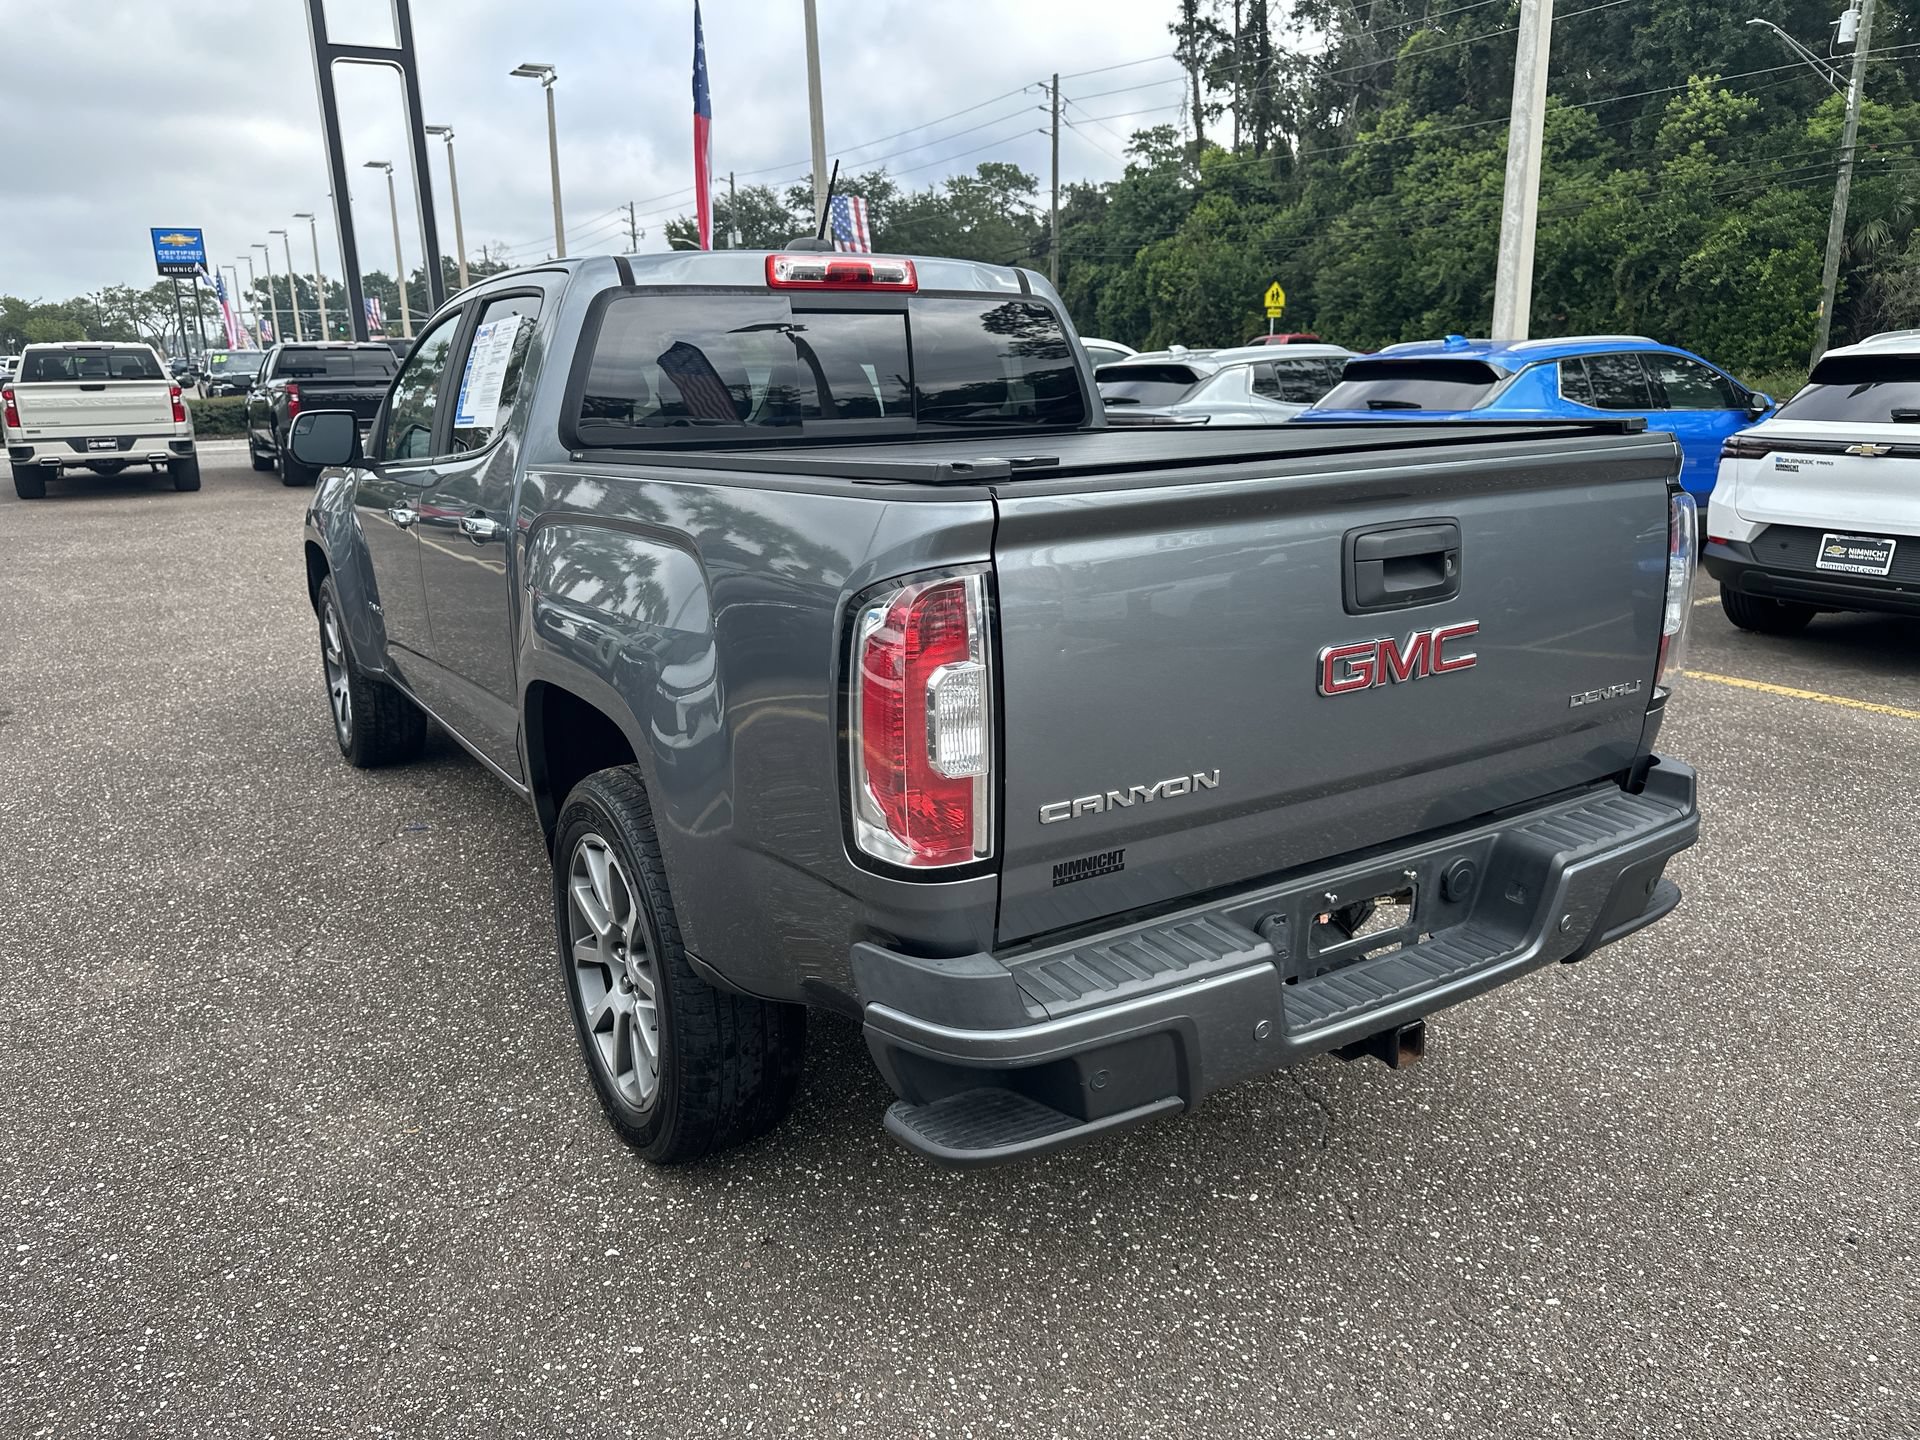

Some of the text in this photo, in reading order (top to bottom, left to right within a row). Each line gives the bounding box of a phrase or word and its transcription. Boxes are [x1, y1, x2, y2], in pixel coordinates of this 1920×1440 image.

[1848, 547, 1888, 558] NIMNICHT
[1317, 619, 1481, 697] GMC
[1569, 679, 1642, 708] DENALI
[1039, 769, 1220, 825] CANYON
[1052, 848, 1126, 879] NIMNICHT
